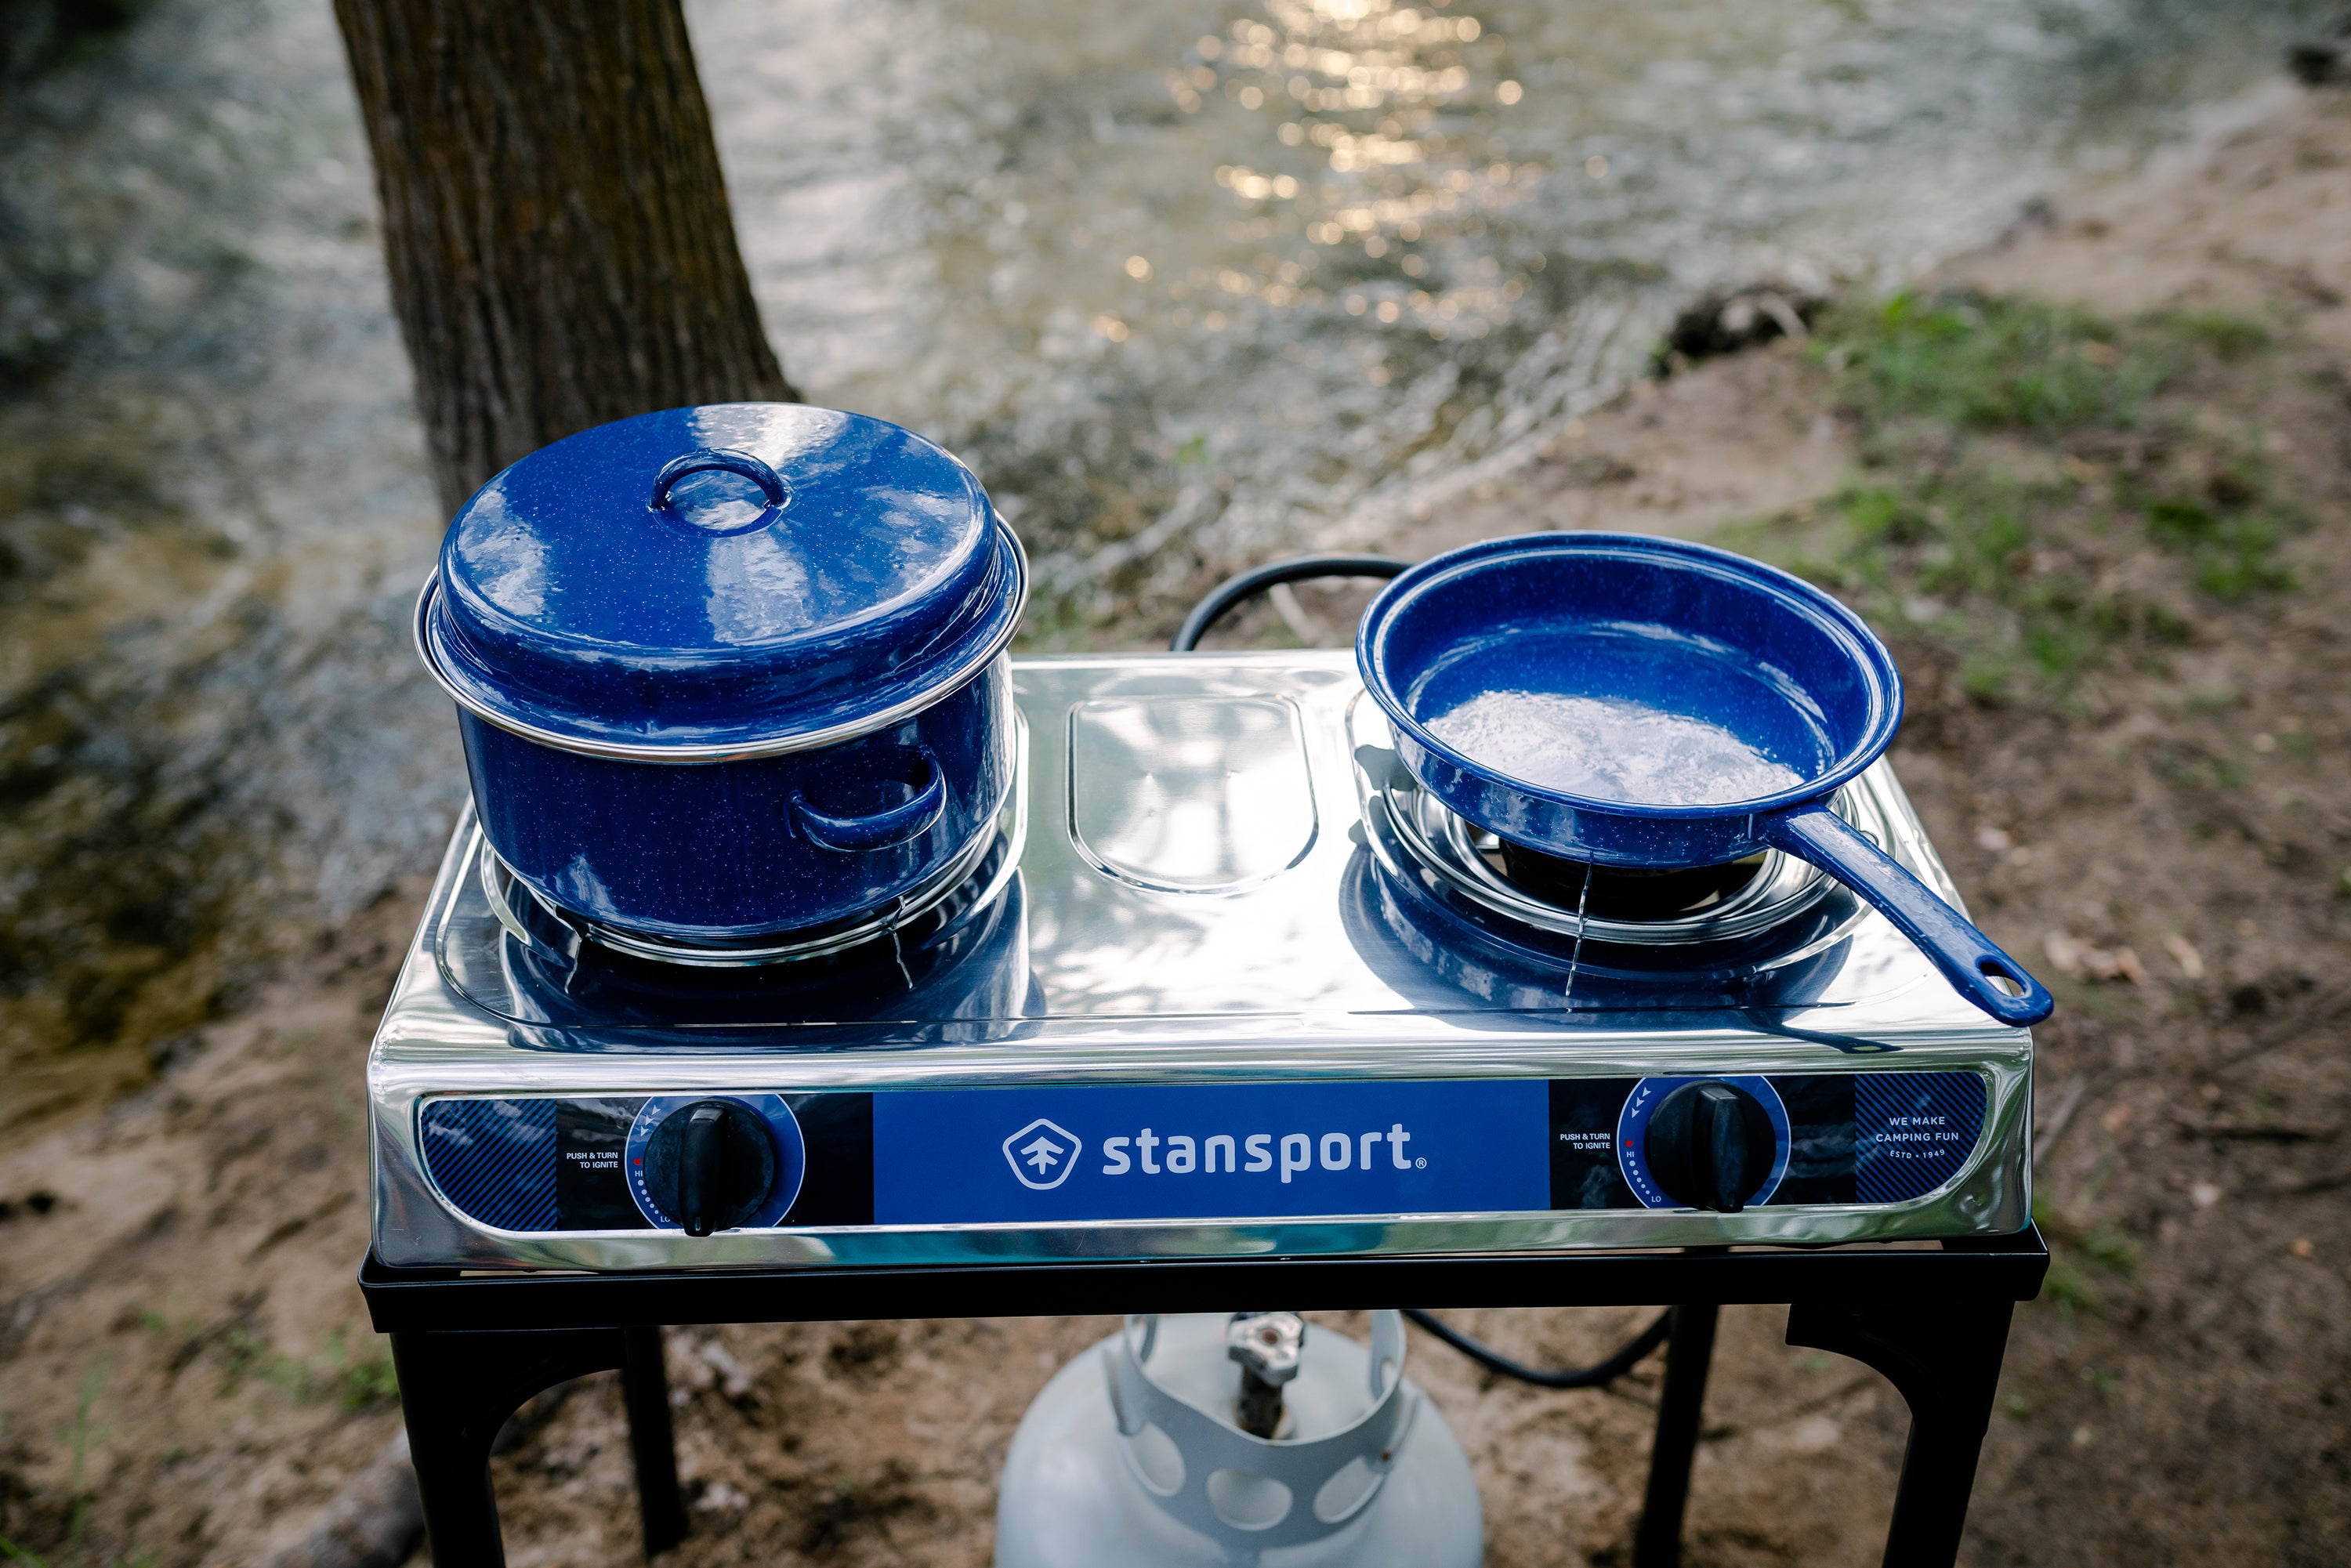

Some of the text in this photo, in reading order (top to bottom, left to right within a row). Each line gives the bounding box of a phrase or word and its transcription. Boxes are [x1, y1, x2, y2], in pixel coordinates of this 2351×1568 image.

[1889, 1116, 1946, 1126] WE MAKE
[1875, 1132, 1959, 1142] CAMPING FUN
[1889, 1149, 1945, 1159] ESTD 1949
